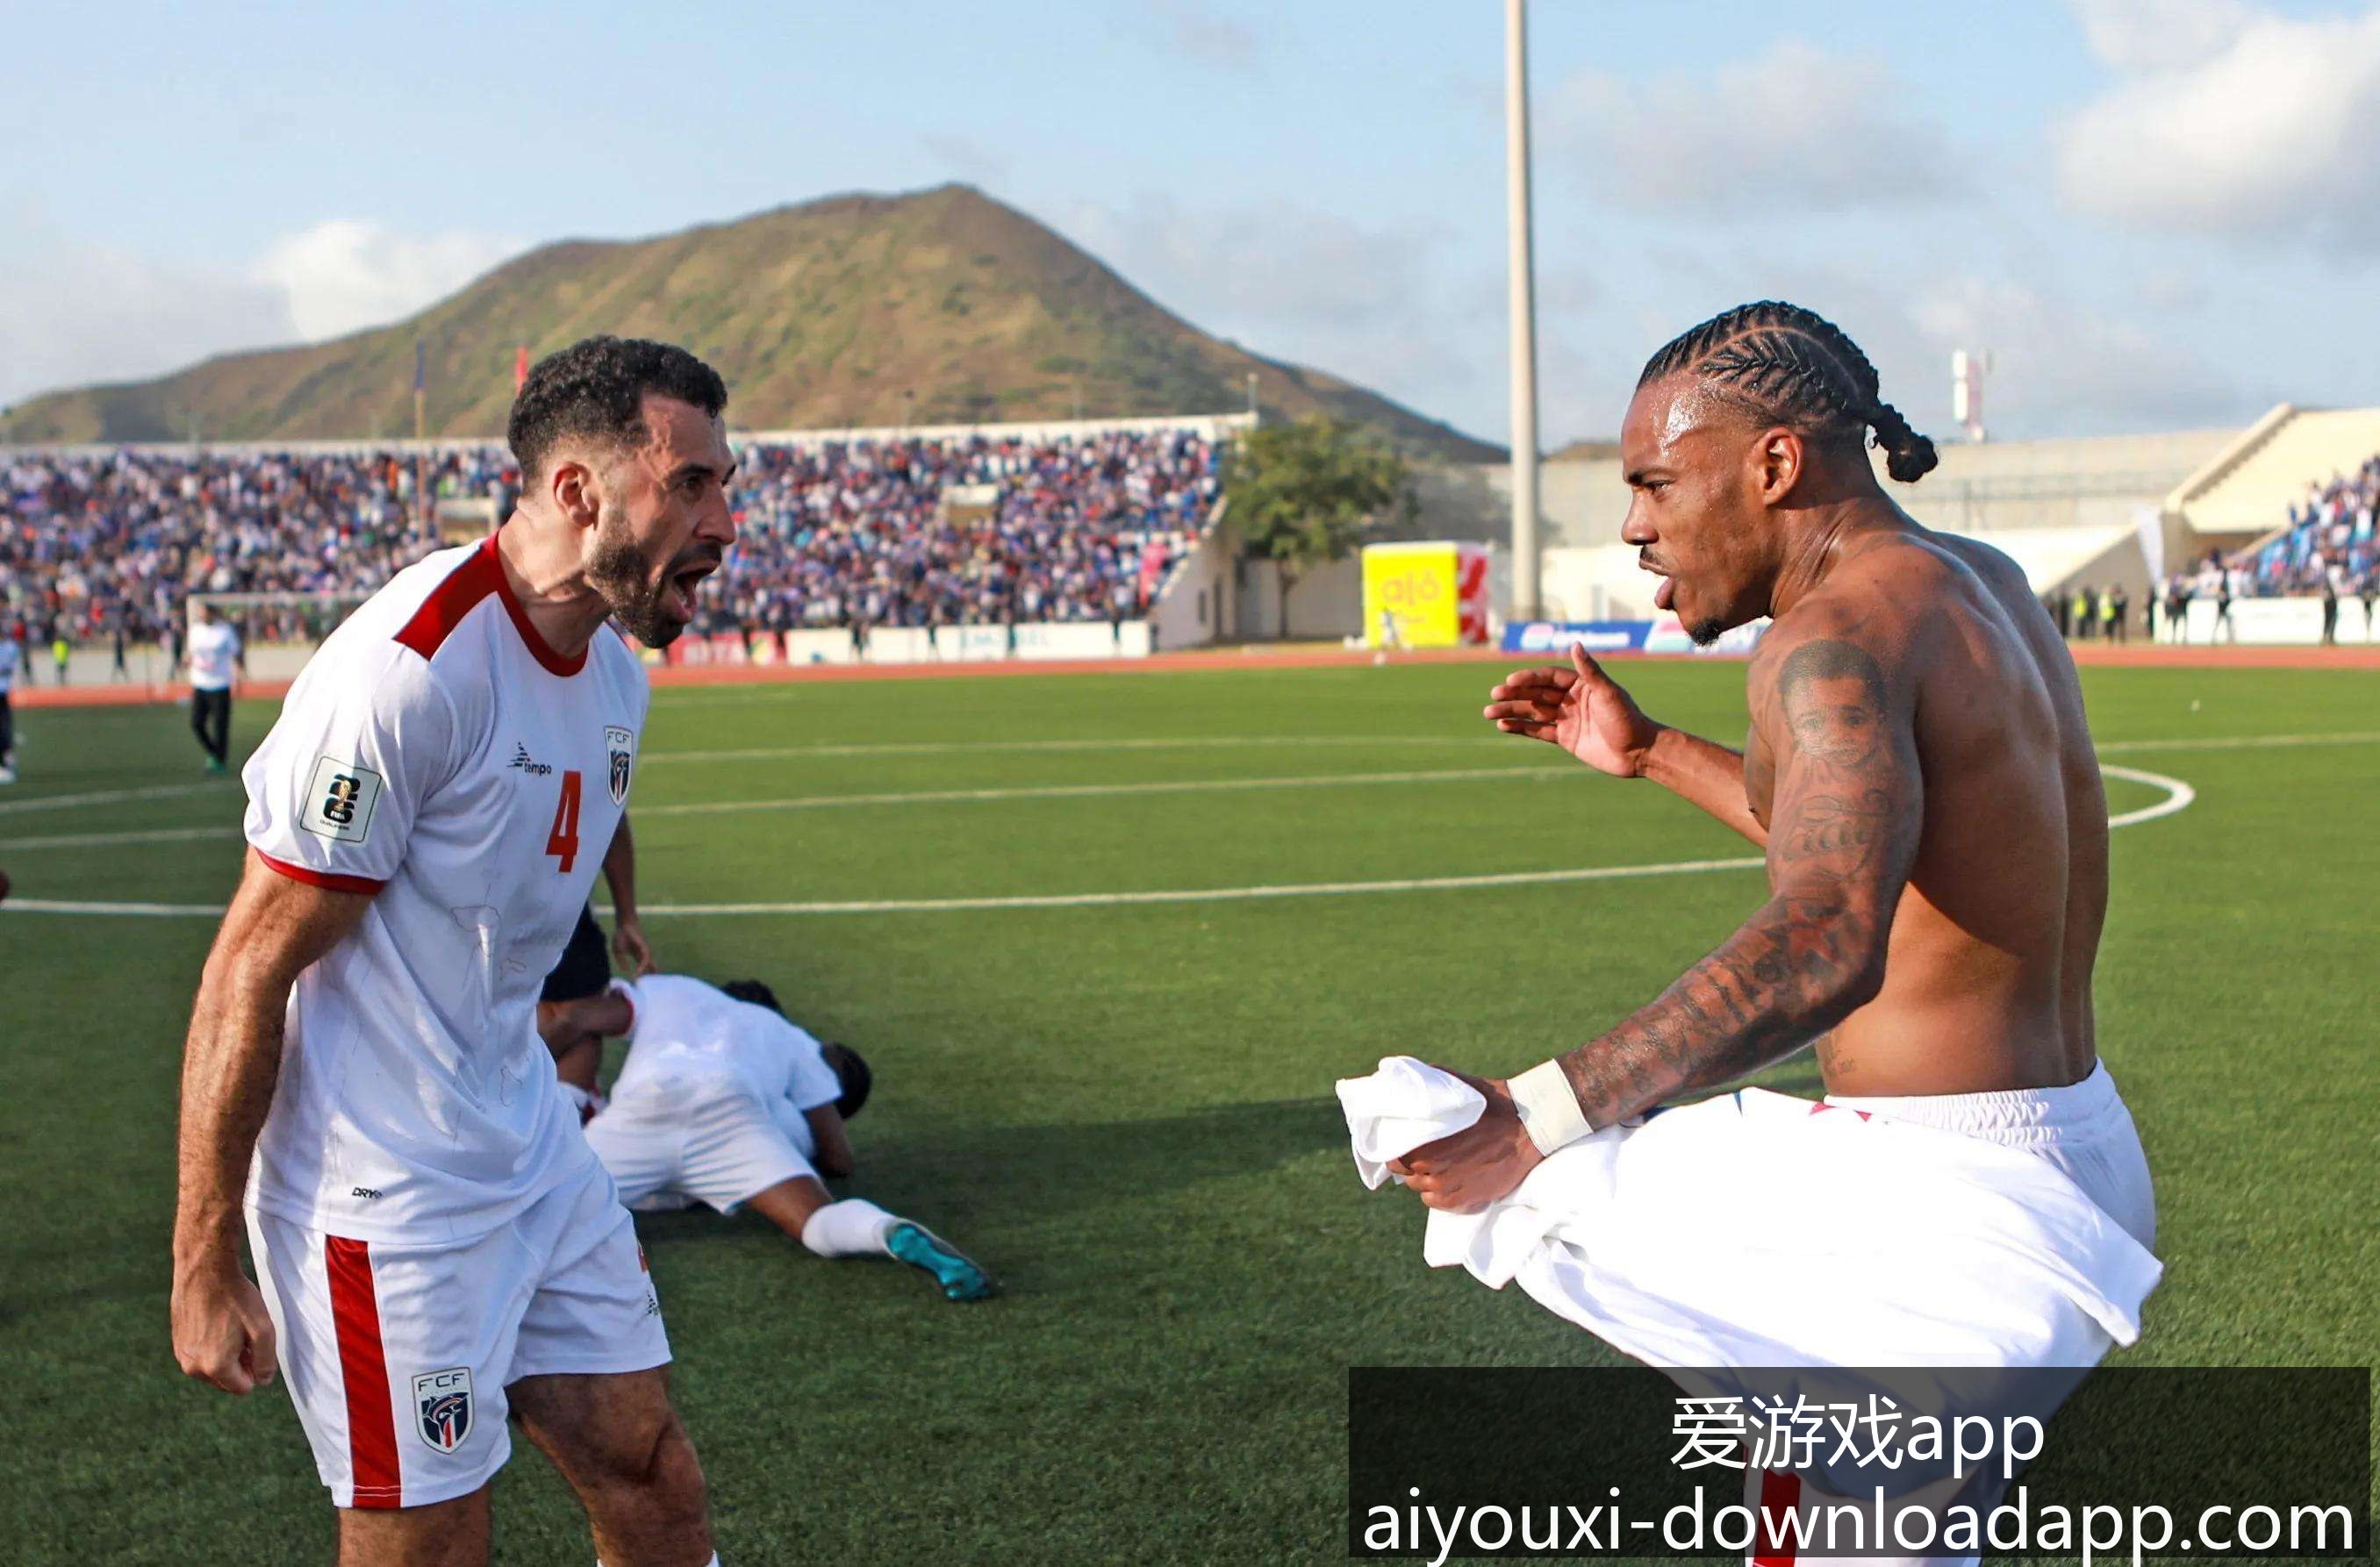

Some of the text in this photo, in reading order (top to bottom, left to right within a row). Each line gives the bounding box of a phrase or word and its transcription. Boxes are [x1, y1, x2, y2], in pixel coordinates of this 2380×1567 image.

[607, 731, 630, 743] FCF
[524, 762, 552, 776] tempo
[546, 769, 582, 872] 4
[418, 1373, 464, 1392] FCF
